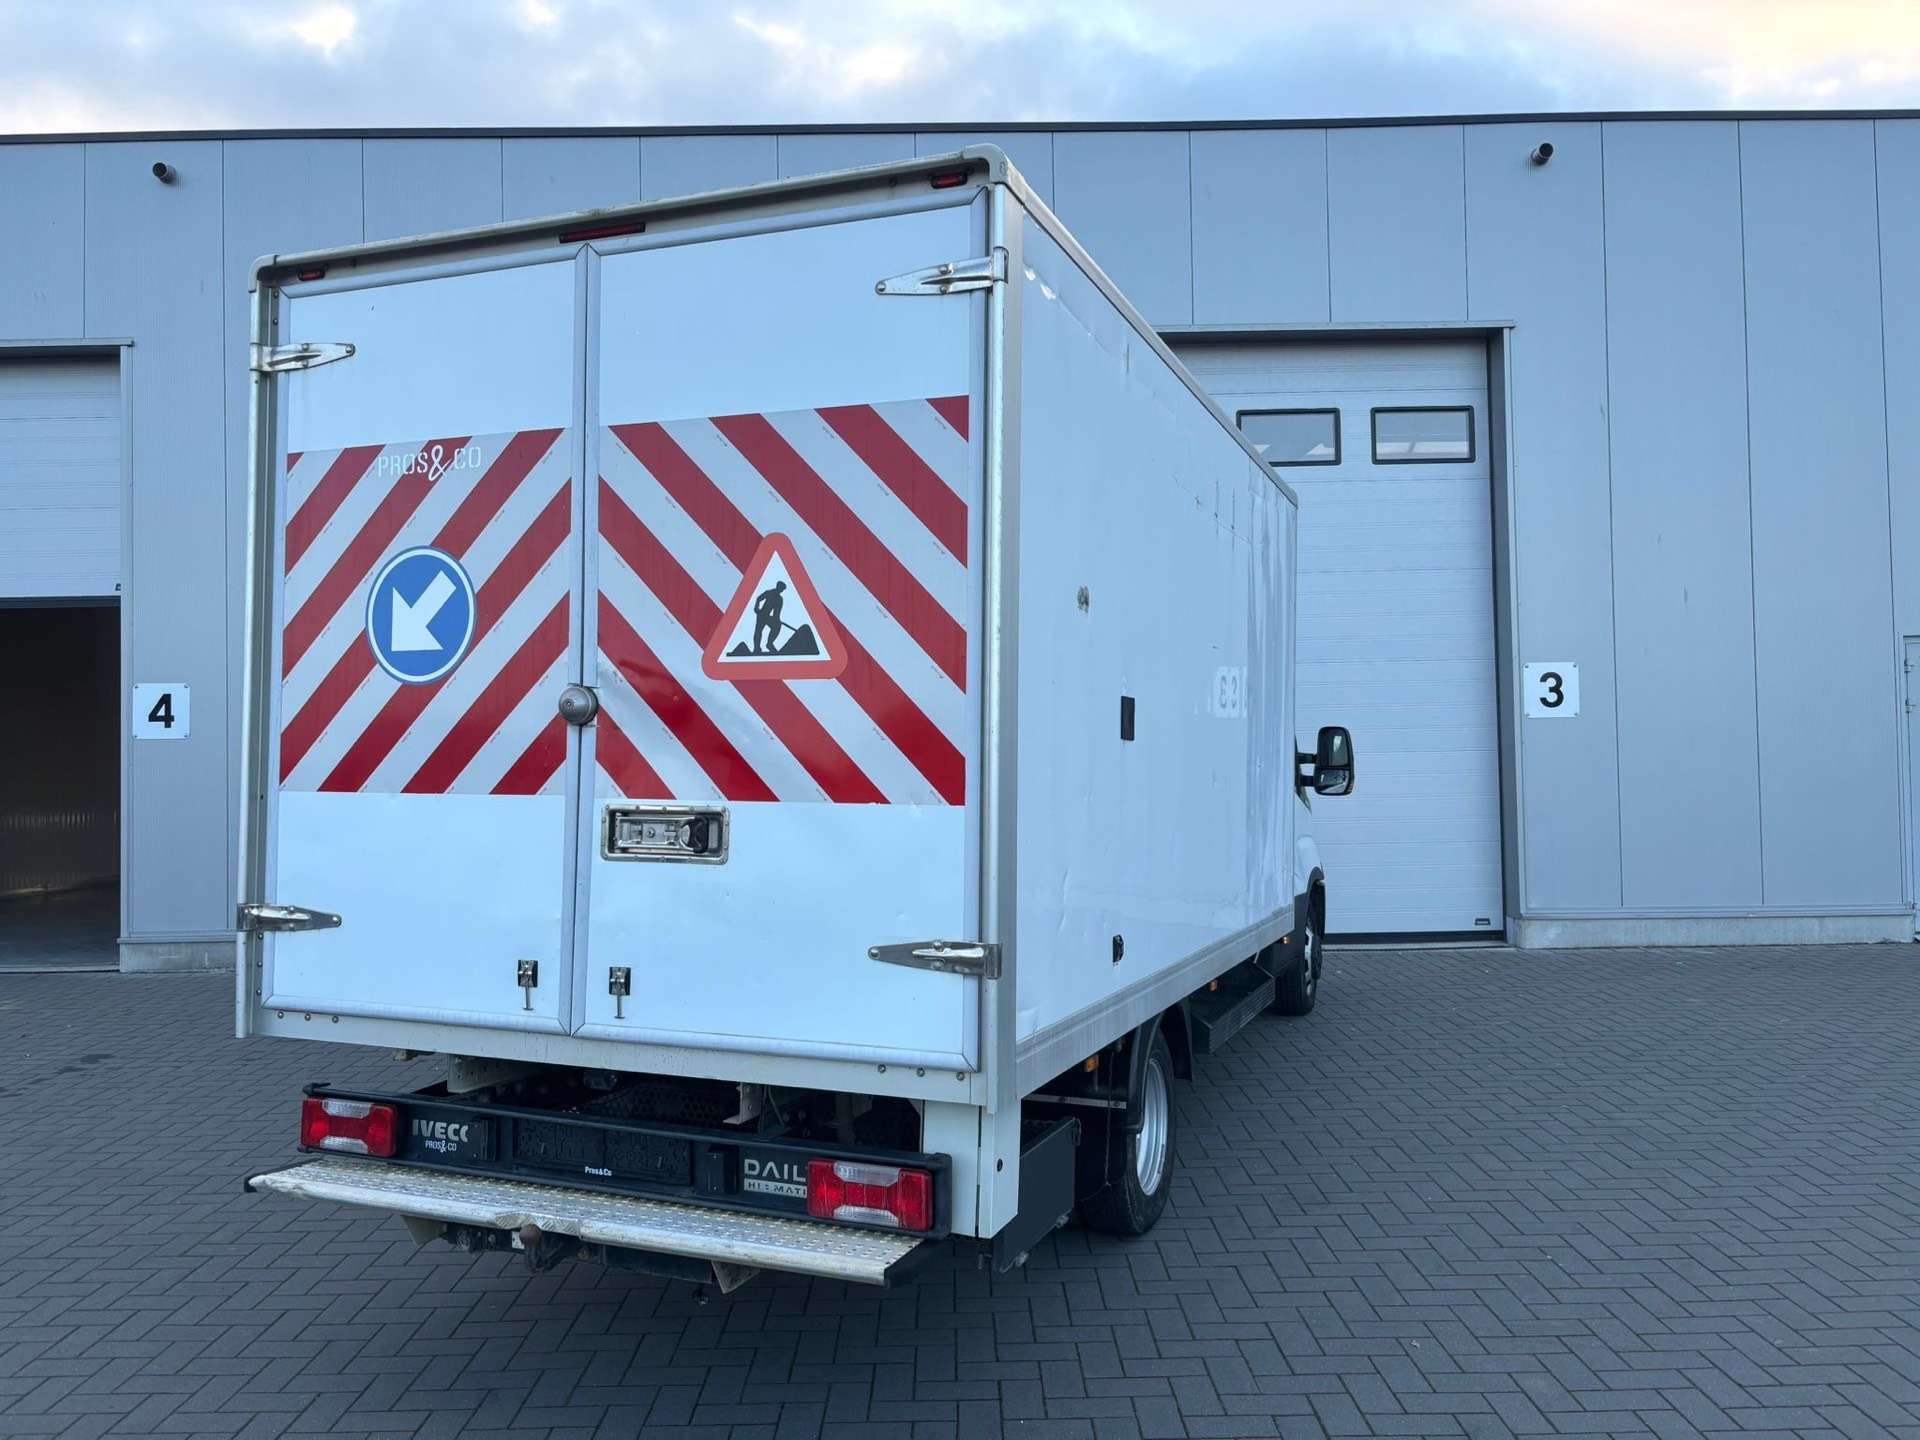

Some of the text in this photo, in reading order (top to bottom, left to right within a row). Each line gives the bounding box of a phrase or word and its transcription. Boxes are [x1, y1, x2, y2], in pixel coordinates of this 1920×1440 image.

[377, 444, 482, 482] PROS&CO
[1539, 671, 1564, 708] 3
[148, 693, 175, 729] 4
[425, 1139, 457, 1153] PROS&CO
[744, 1158, 807, 1183] DAIL
